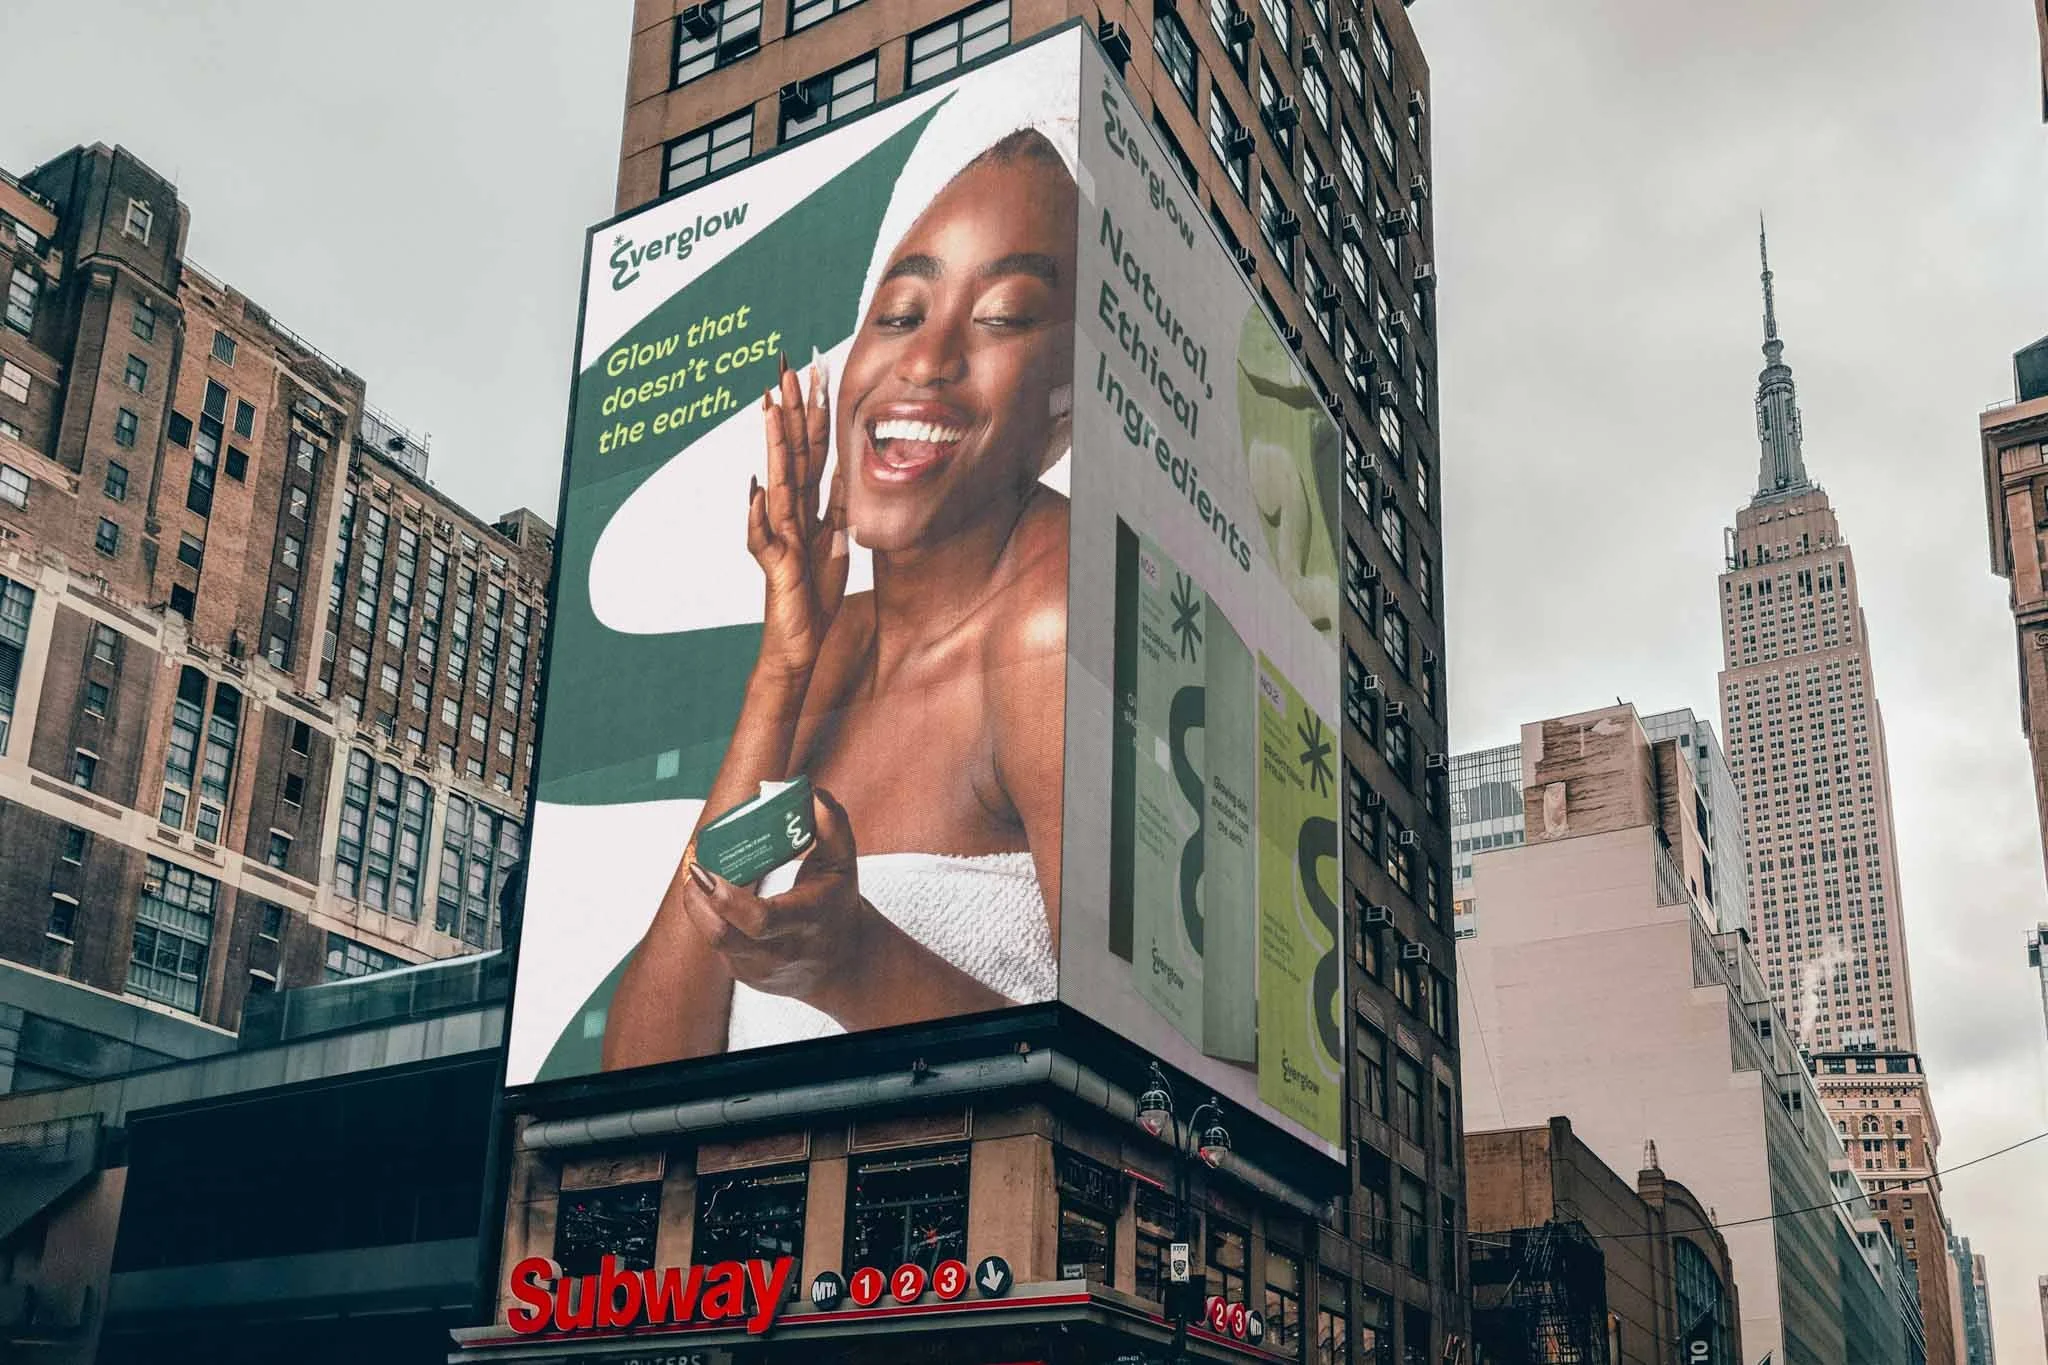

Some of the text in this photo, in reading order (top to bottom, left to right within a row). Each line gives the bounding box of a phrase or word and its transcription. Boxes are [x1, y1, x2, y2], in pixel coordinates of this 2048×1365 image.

[1102, 88, 1194, 249] Everglow
[609, 202, 749, 291] Everglow
[606, 304, 751, 377] Glow that
[1100, 207, 1213, 400] Natural,
[601, 330, 782, 416] doesn't cost
[1098, 279, 1199, 440] Ethical
[599, 385, 738, 454] the earth.
[1096, 351, 1252, 573] Ingredients
[507, 1254, 958, 1335] Subway MTA 1 2 3
[1216, 1303, 1224, 1327] 2
[1235, 1310, 1243, 1332] 3
